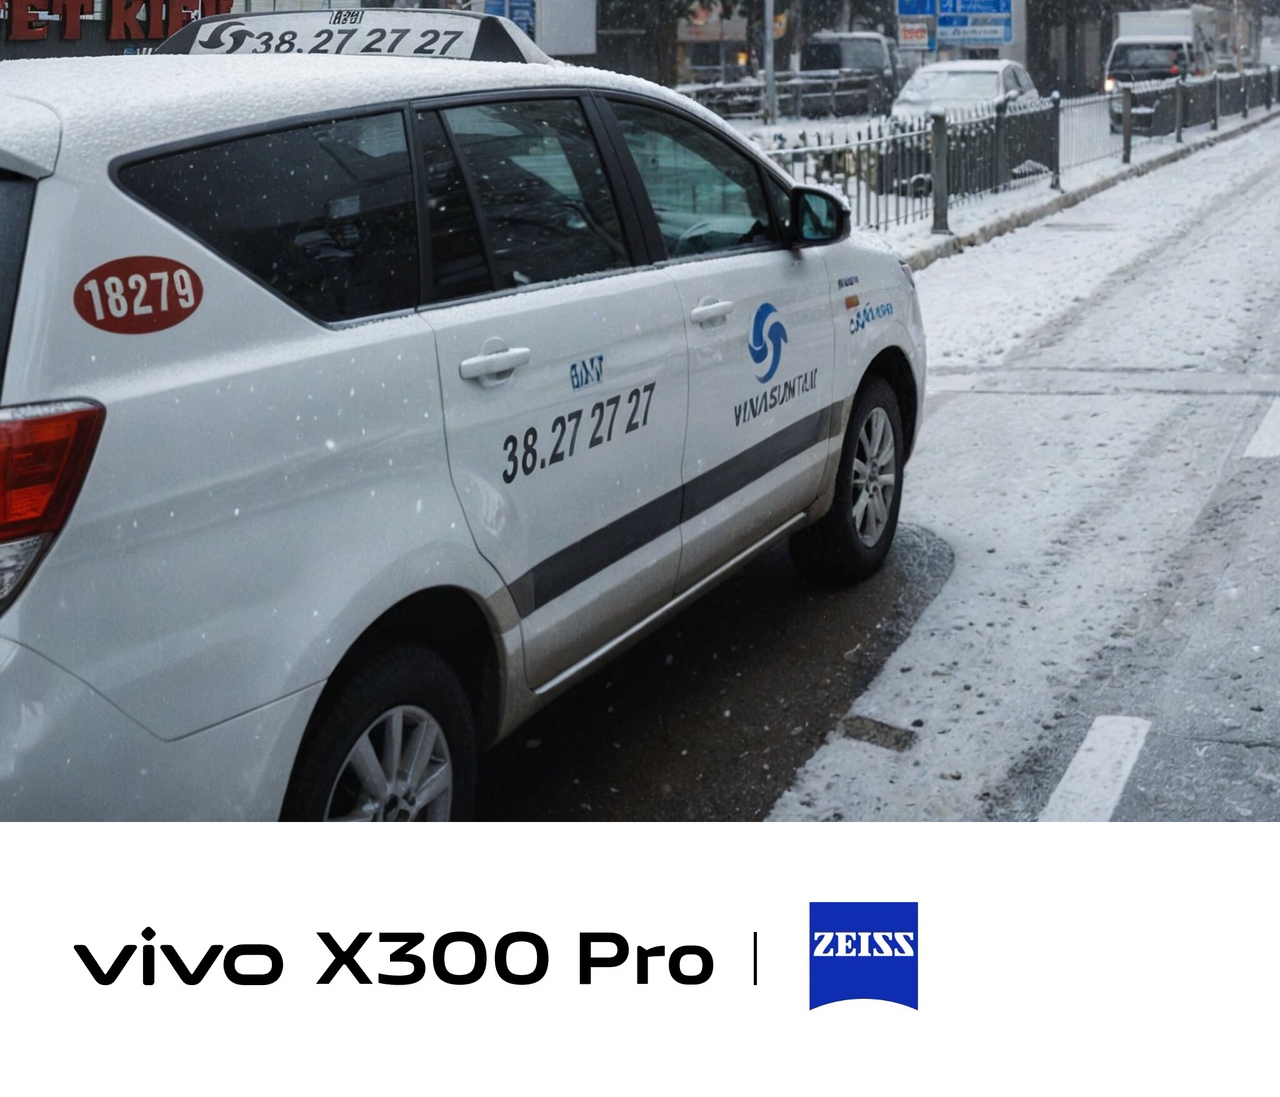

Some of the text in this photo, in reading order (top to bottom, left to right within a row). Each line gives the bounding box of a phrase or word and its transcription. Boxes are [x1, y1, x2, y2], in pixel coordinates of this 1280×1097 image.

[252, 28, 464, 56] 38.27 27 27
[84, 269, 195, 321] 18279
[502, 381, 656, 484] 38.27 27 27
